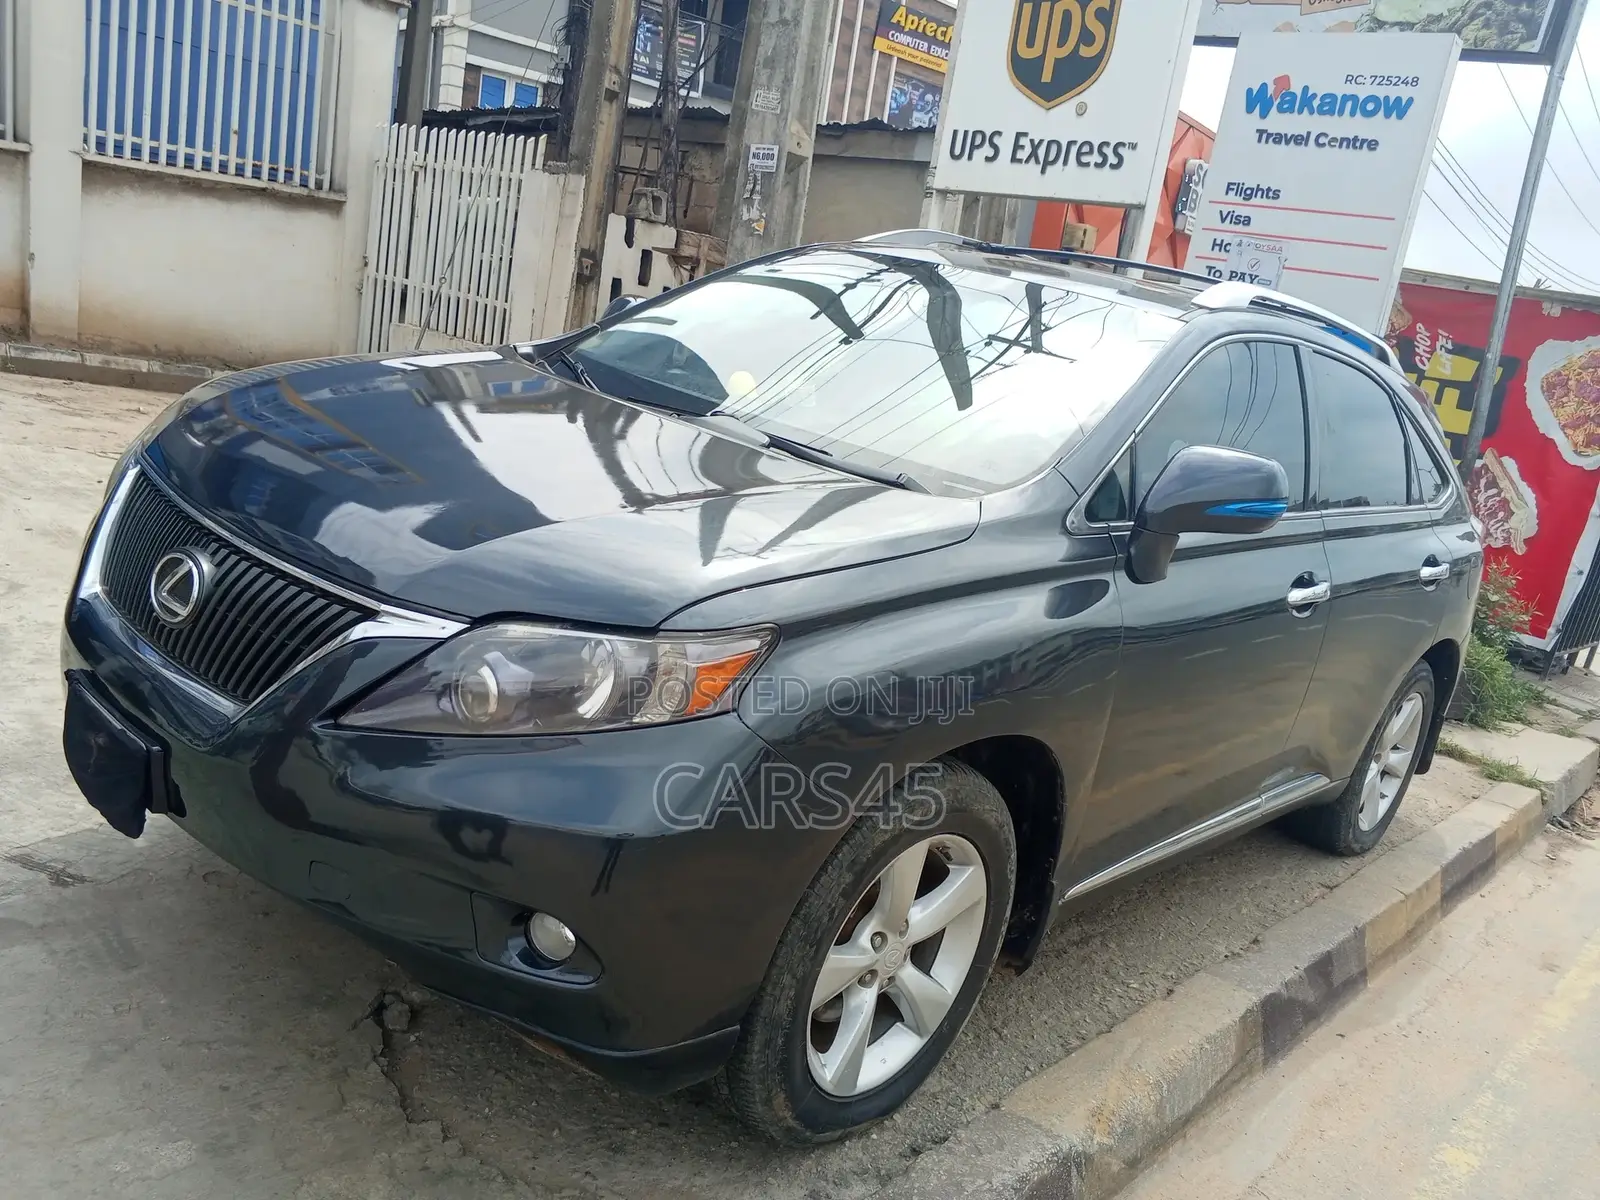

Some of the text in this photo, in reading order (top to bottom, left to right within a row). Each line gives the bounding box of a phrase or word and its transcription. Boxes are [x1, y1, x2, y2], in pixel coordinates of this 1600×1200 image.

[890, 6, 954, 44] Aptech
[888, 30, 928, 54] COMPUTER
[1344, 74, 1420, 87] RC: 725248
[1245, 81, 1415, 120] Wakanow
[950, 129, 1003, 163] UPS
[1256, 129, 1380, 151] Travel Centre
[1225, 181, 1281, 201] Flights
[1219, 209, 1252, 227] Visa
[1414, 322, 1432, 371] CHOP
